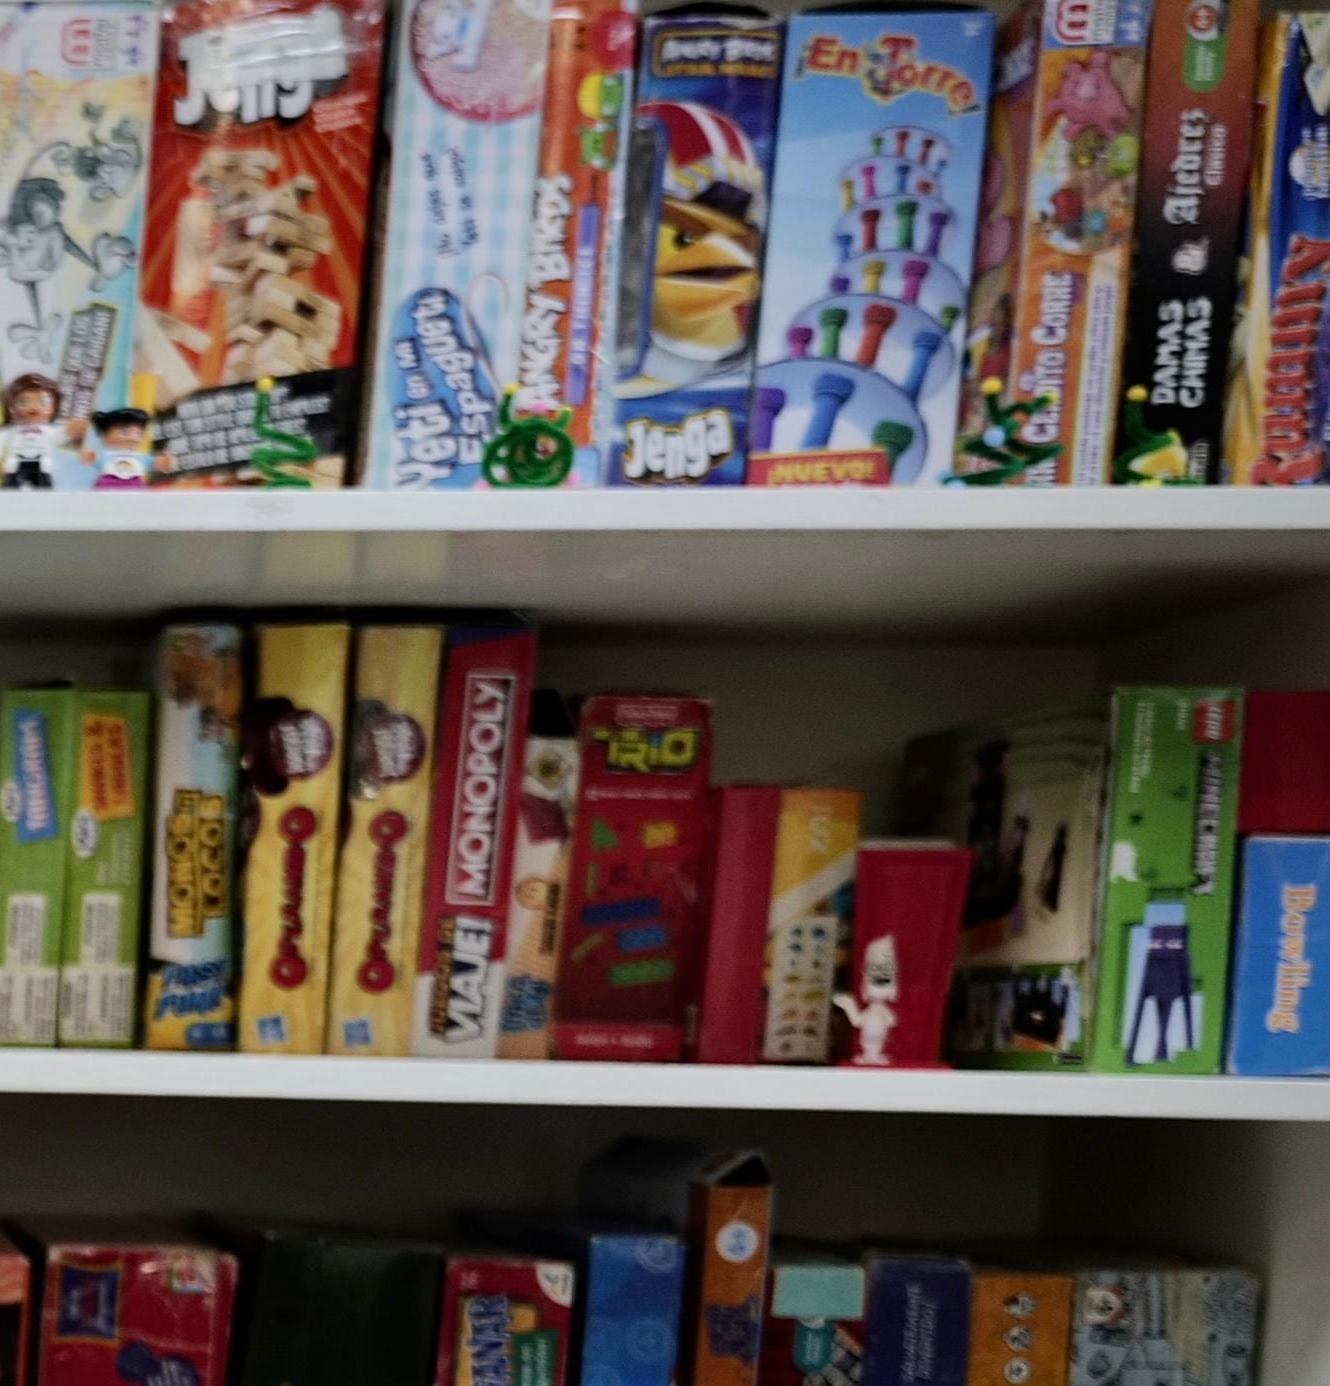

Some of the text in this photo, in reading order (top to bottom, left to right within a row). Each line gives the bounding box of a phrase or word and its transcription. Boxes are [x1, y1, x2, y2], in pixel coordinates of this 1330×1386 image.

[806, 35, 860, 74] En
[878, 35, 975, 108] Torre
[1162, 107, 1208, 226] Ajedrez
[514, 174, 575, 412] ANGRY BIRDS
[1150, 298, 1185, 407] DAMAS
[1178, 296, 1214, 409] CHINAS
[1020, 271, 1074, 445] CEDITO CORRE
[624, 405, 734, 482] Jenga
[455, 678, 507, 898] MONOPOLY
[445, 916, 497, 1041] VIAJE!
[1266, 884, 1318, 1034] Bowling
